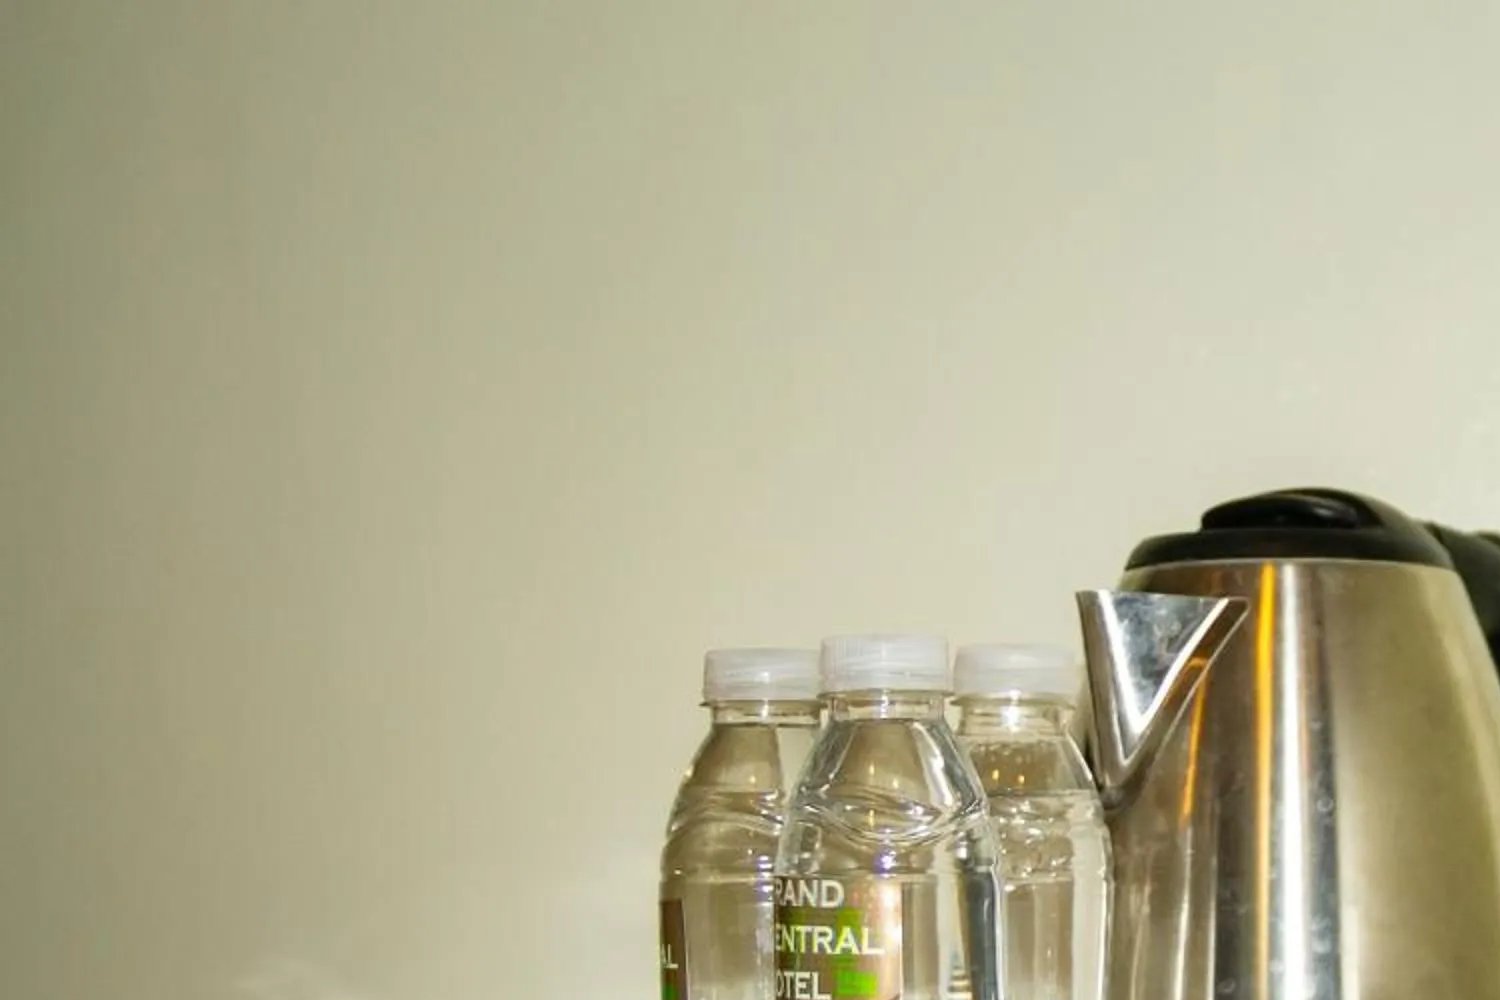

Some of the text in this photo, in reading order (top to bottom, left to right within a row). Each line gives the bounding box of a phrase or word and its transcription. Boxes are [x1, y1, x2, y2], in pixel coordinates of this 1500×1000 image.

[775, 879, 845, 908] RAND
[775, 924, 885, 955] ENTRAL
[775, 968, 832, 1000] OTEL
